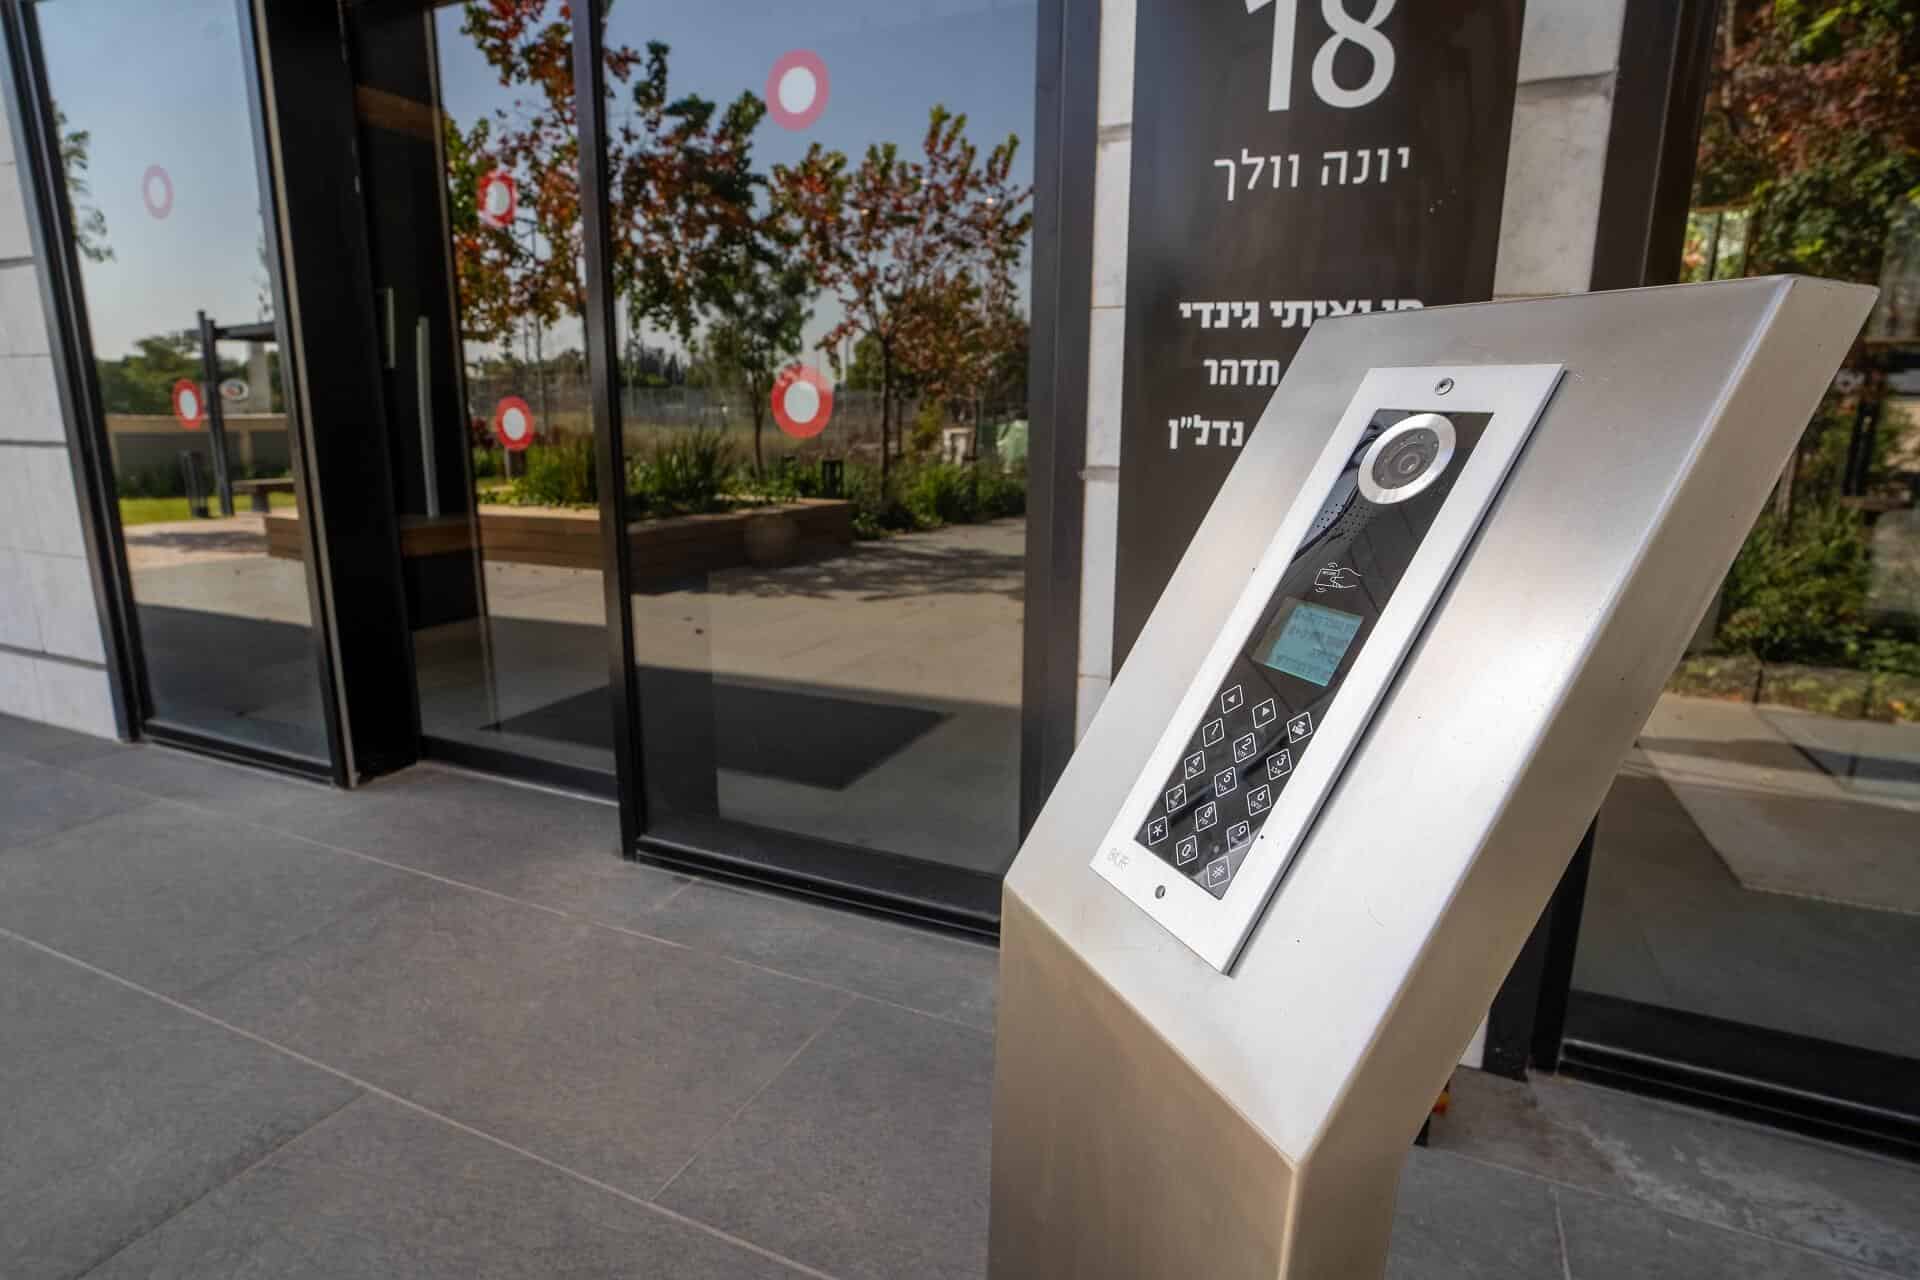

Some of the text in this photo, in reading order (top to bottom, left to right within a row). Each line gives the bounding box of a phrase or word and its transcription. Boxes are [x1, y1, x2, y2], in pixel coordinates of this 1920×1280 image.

[1244, 0, 1397, 112] 18
[1213, 145, 1411, 202] יונה וולך
[1178, 300, 1260, 329] גינדי
[1203, 358, 1280, 387] תדהר
